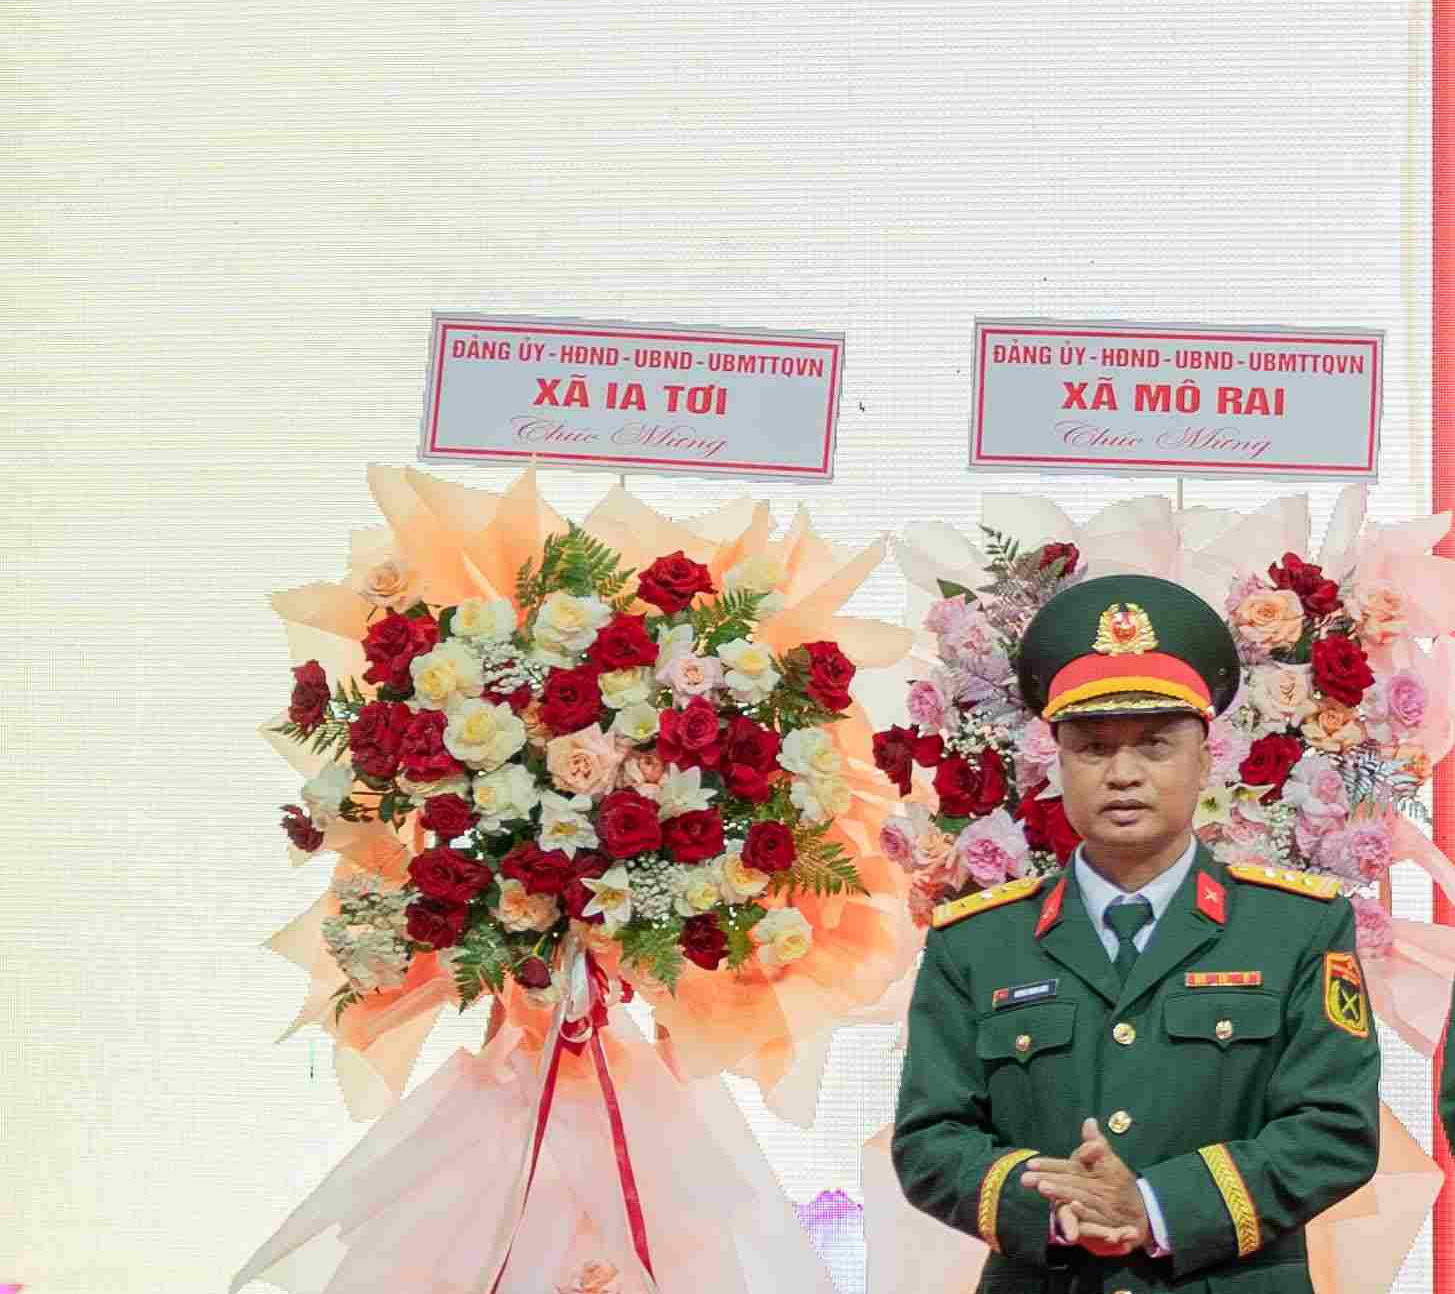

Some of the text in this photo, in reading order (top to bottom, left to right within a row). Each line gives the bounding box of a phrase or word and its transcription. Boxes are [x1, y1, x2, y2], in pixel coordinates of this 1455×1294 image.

[453, 333, 511, 361] ĐẢNG
[518, 335, 545, 362] ỦY
[560, 344, 619, 366] HĐND
[634, 348, 693, 371] UBND
[708, 352, 824, 378] UBMTTQVN
[993, 338, 1052, 365] ĐẢNG
[1060, 340, 1087, 366] ỦY
[1101, 347, 1160, 369] HĐND
[1175, 349, 1234, 371] UBND
[1249, 352, 1365, 375] UBMTTQVN
[533, 373, 728, 416] XÃ IA TƠI
[1062, 376, 1286, 416] XÃ MÔ RAI
